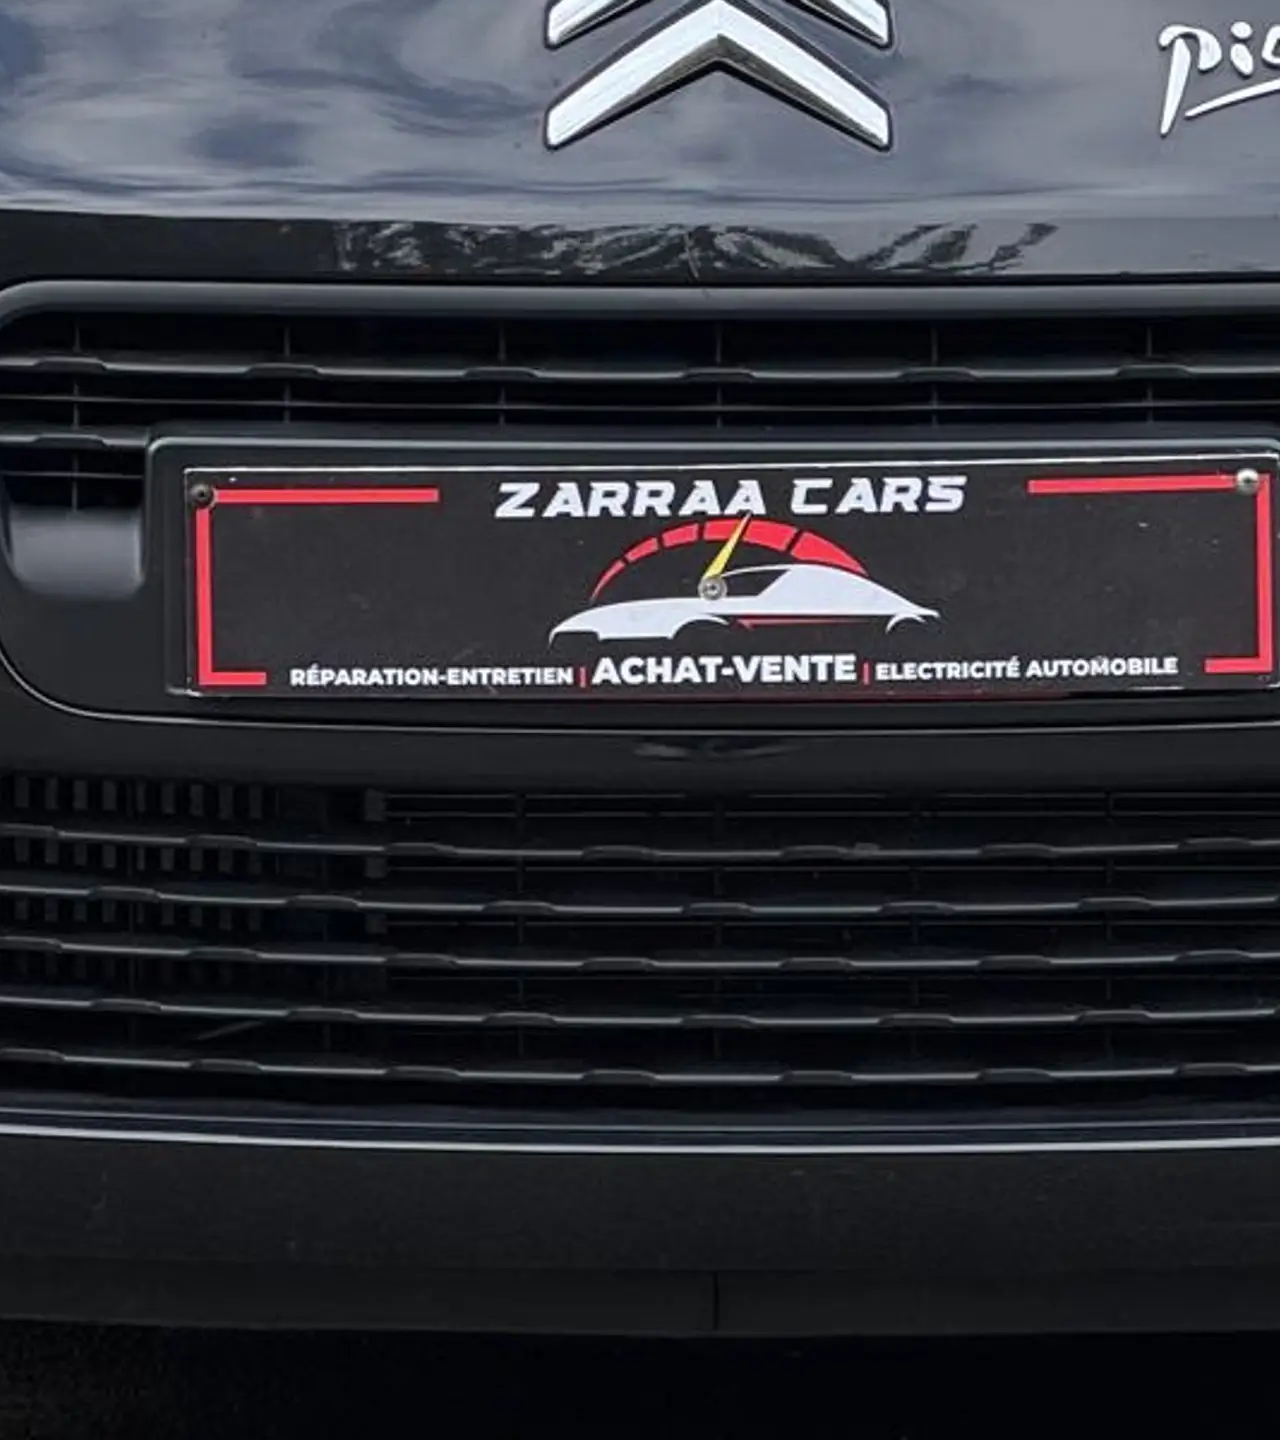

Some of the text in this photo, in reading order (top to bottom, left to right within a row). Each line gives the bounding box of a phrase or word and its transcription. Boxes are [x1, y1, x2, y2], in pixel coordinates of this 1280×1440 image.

[494, 475, 968, 518] ZARRAA CARS
[289, 654, 1178, 687] RÉPARATION-ENTRETIEN ACHAT-VENTE ELECTRICITÉ AUTOMOBILE
